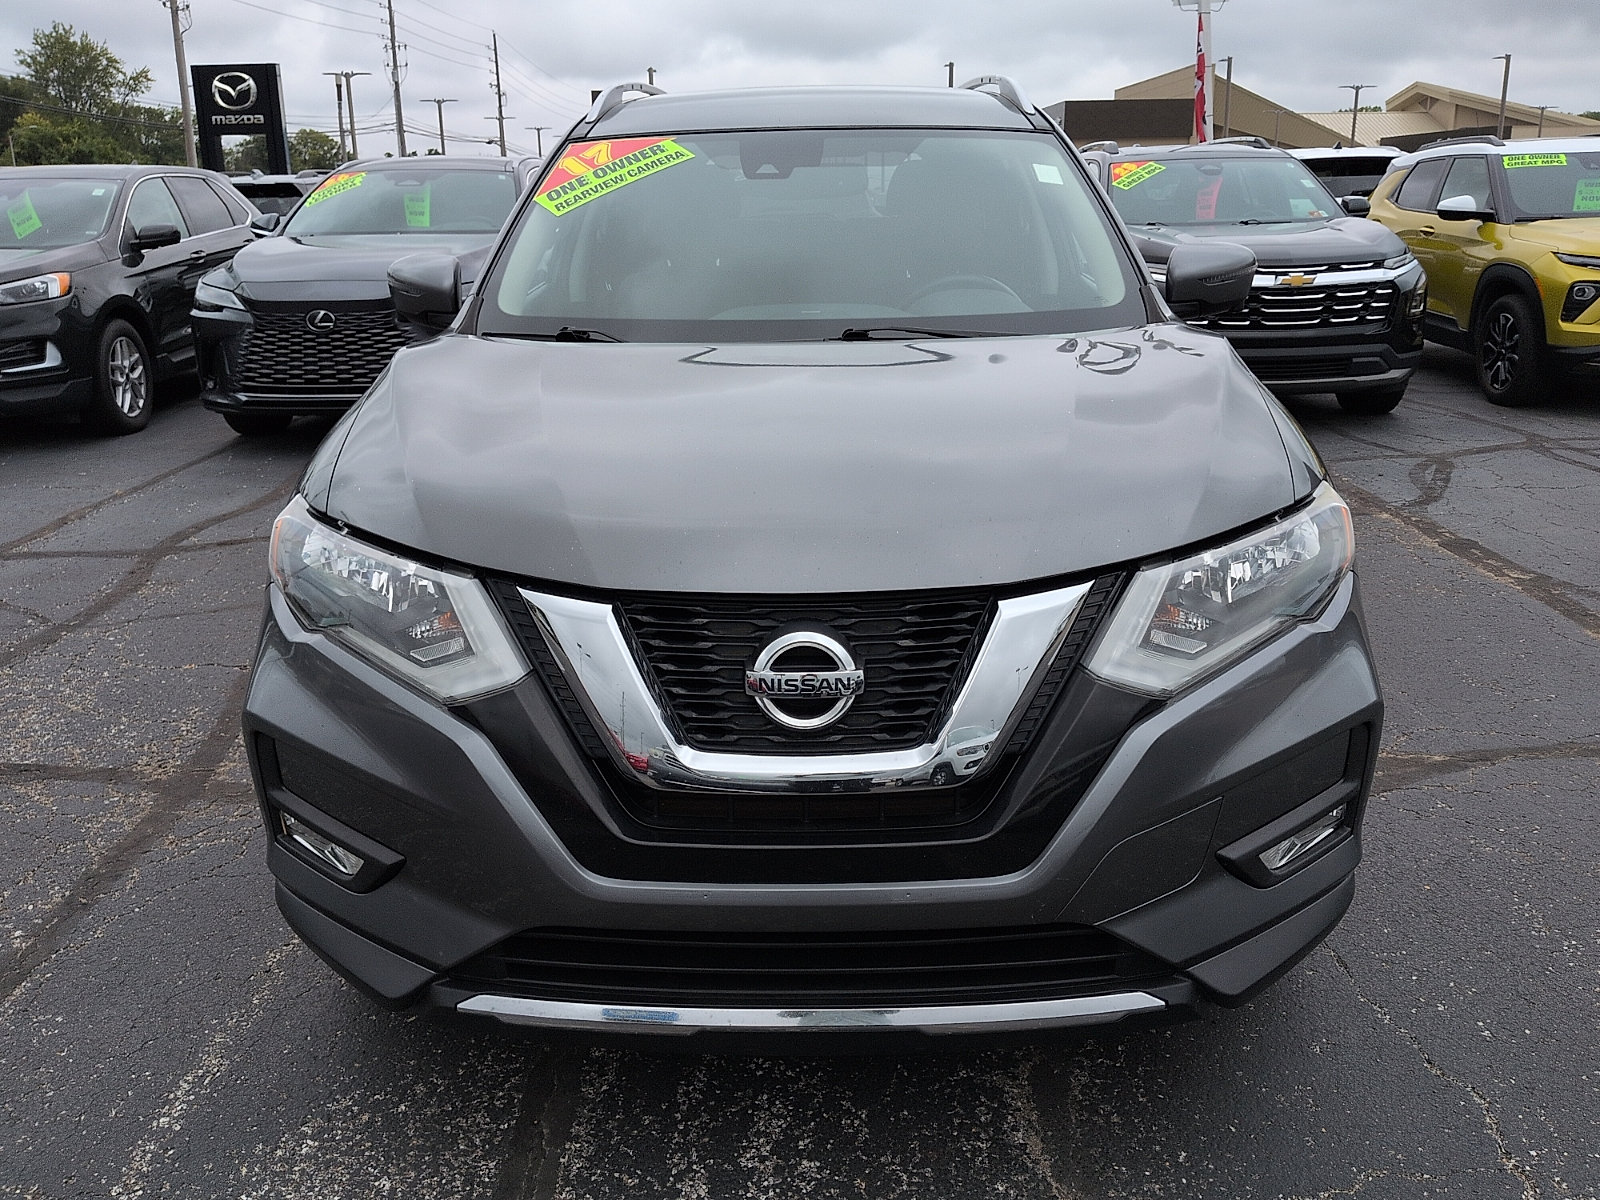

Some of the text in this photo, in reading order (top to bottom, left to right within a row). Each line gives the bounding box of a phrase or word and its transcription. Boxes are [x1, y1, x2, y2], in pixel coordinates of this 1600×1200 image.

[211, 114, 265, 125] mazda
[559, 142, 612, 176] 17
[546, 144, 667, 202] ONE OWNER
[554, 150, 686, 212] REARVIEW CAMERA
[1122, 166, 1162, 187] GREAT MPG
[758, 677, 851, 693] NISSAN
